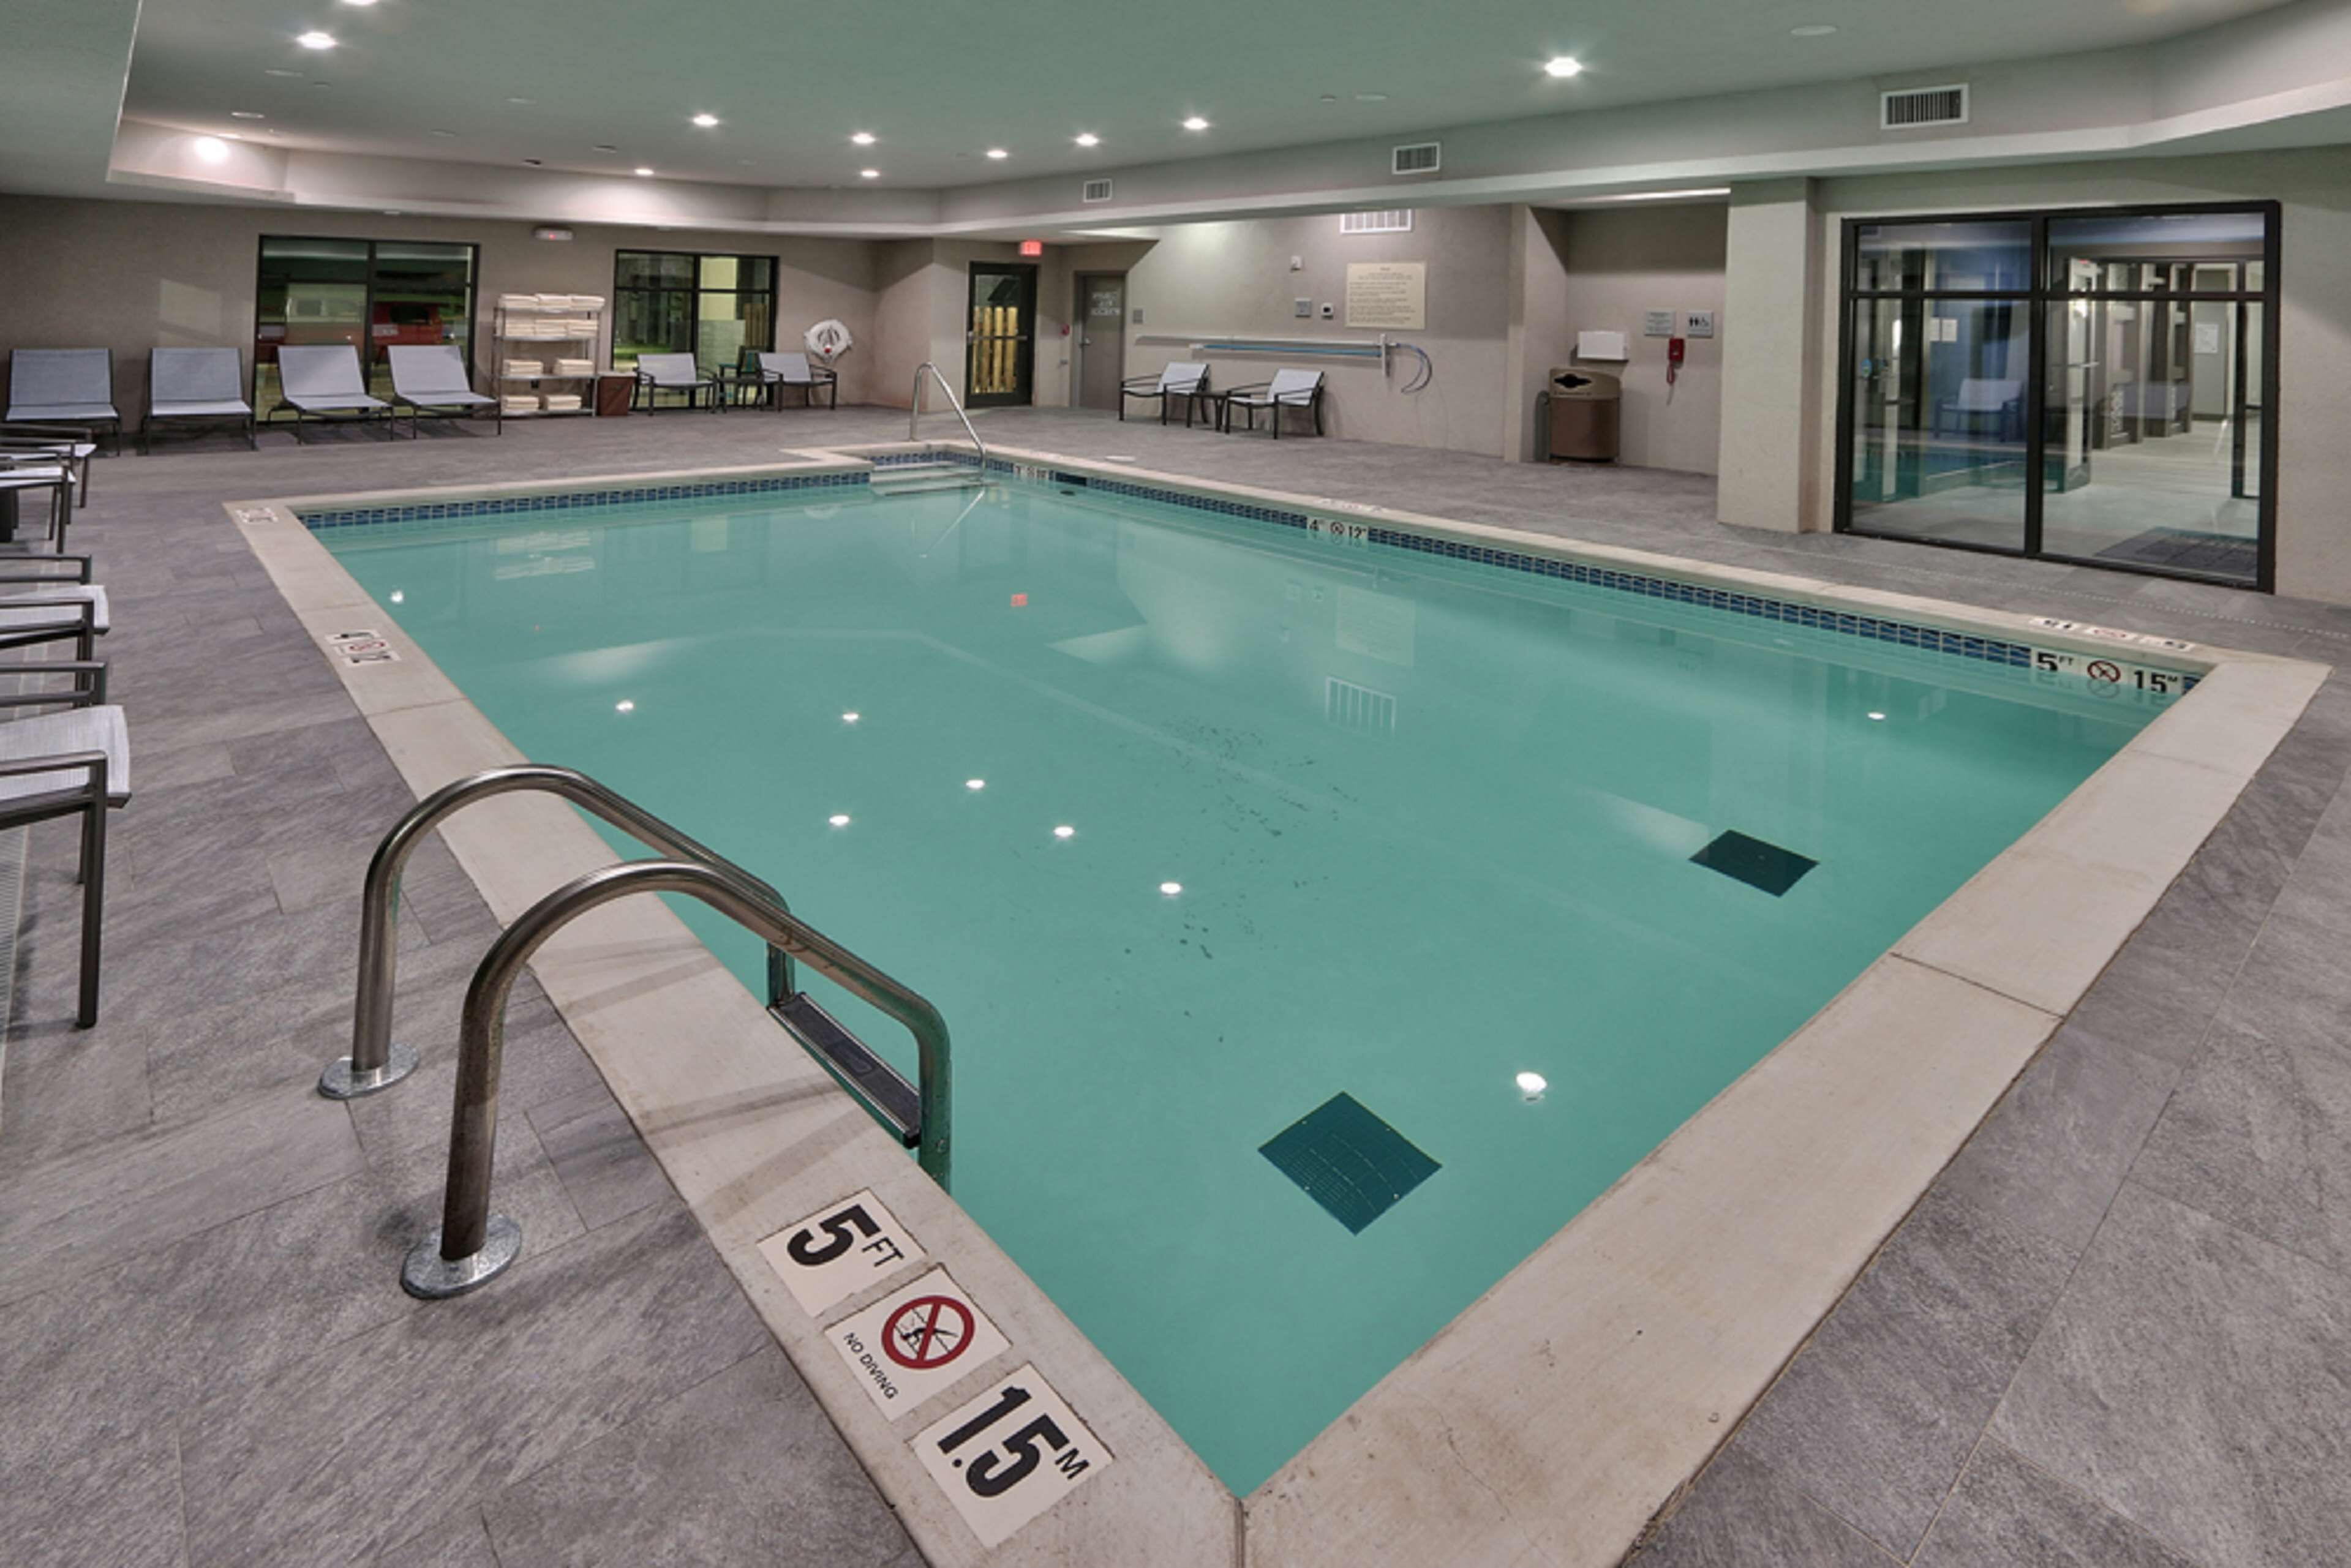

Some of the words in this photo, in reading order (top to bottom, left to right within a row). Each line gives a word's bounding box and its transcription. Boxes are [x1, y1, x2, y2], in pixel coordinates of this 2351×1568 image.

[2037, 651, 2058, 672] 5
[787, 1204, 881, 1266] 5
[862, 1237, 905, 1267] FT
[843, 1332, 863, 1352] NO
[859, 1354, 898, 1400] DIVING
[937, 1386, 1070, 1498] 1.5
[1055, 1447, 1089, 1480] M
